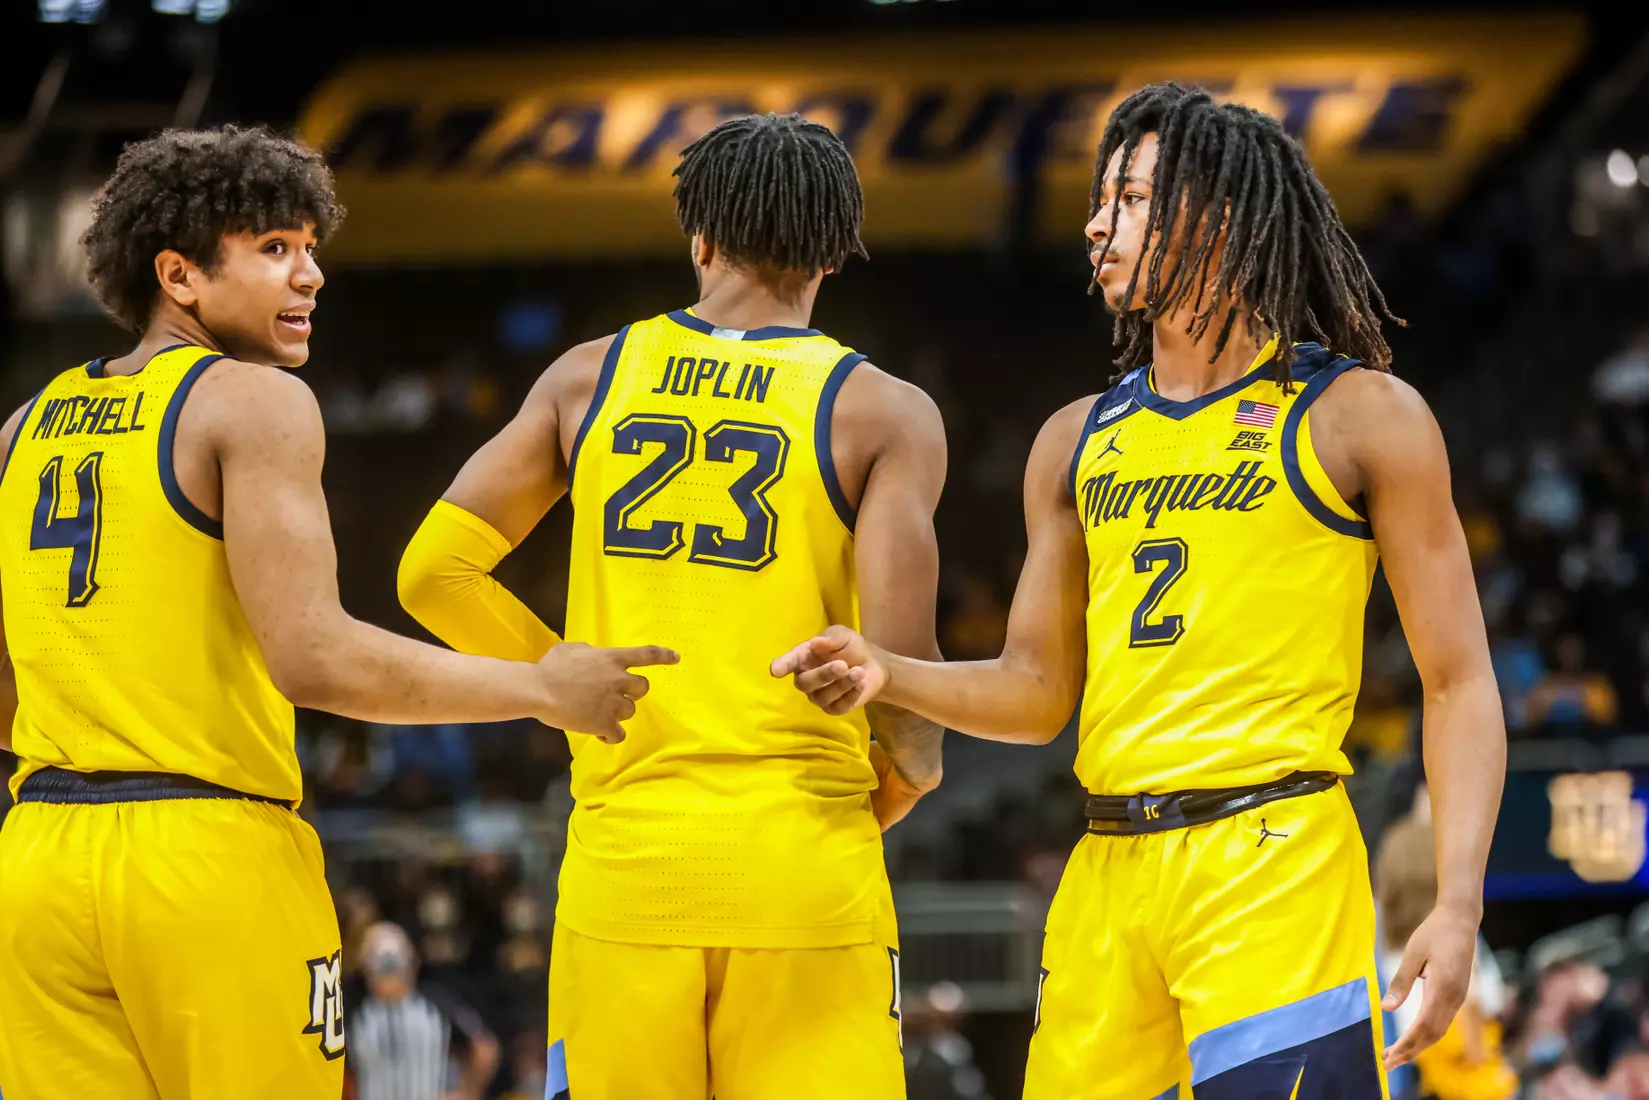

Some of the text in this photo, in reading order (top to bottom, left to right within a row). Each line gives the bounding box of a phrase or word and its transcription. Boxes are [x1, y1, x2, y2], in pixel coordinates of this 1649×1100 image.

[326, 78, 1468, 178] MARUETE
[652, 356, 775, 403] JOPLIN
[31, 391, 145, 440] MITCHELL
[1230, 439, 1273, 450] EAST
[1236, 430, 1267, 441] BIG
[604, 413, 791, 572] 23
[1081, 461, 1277, 532] Marquette
[30, 451, 104, 608] 4
[1128, 536, 1189, 649] 2
